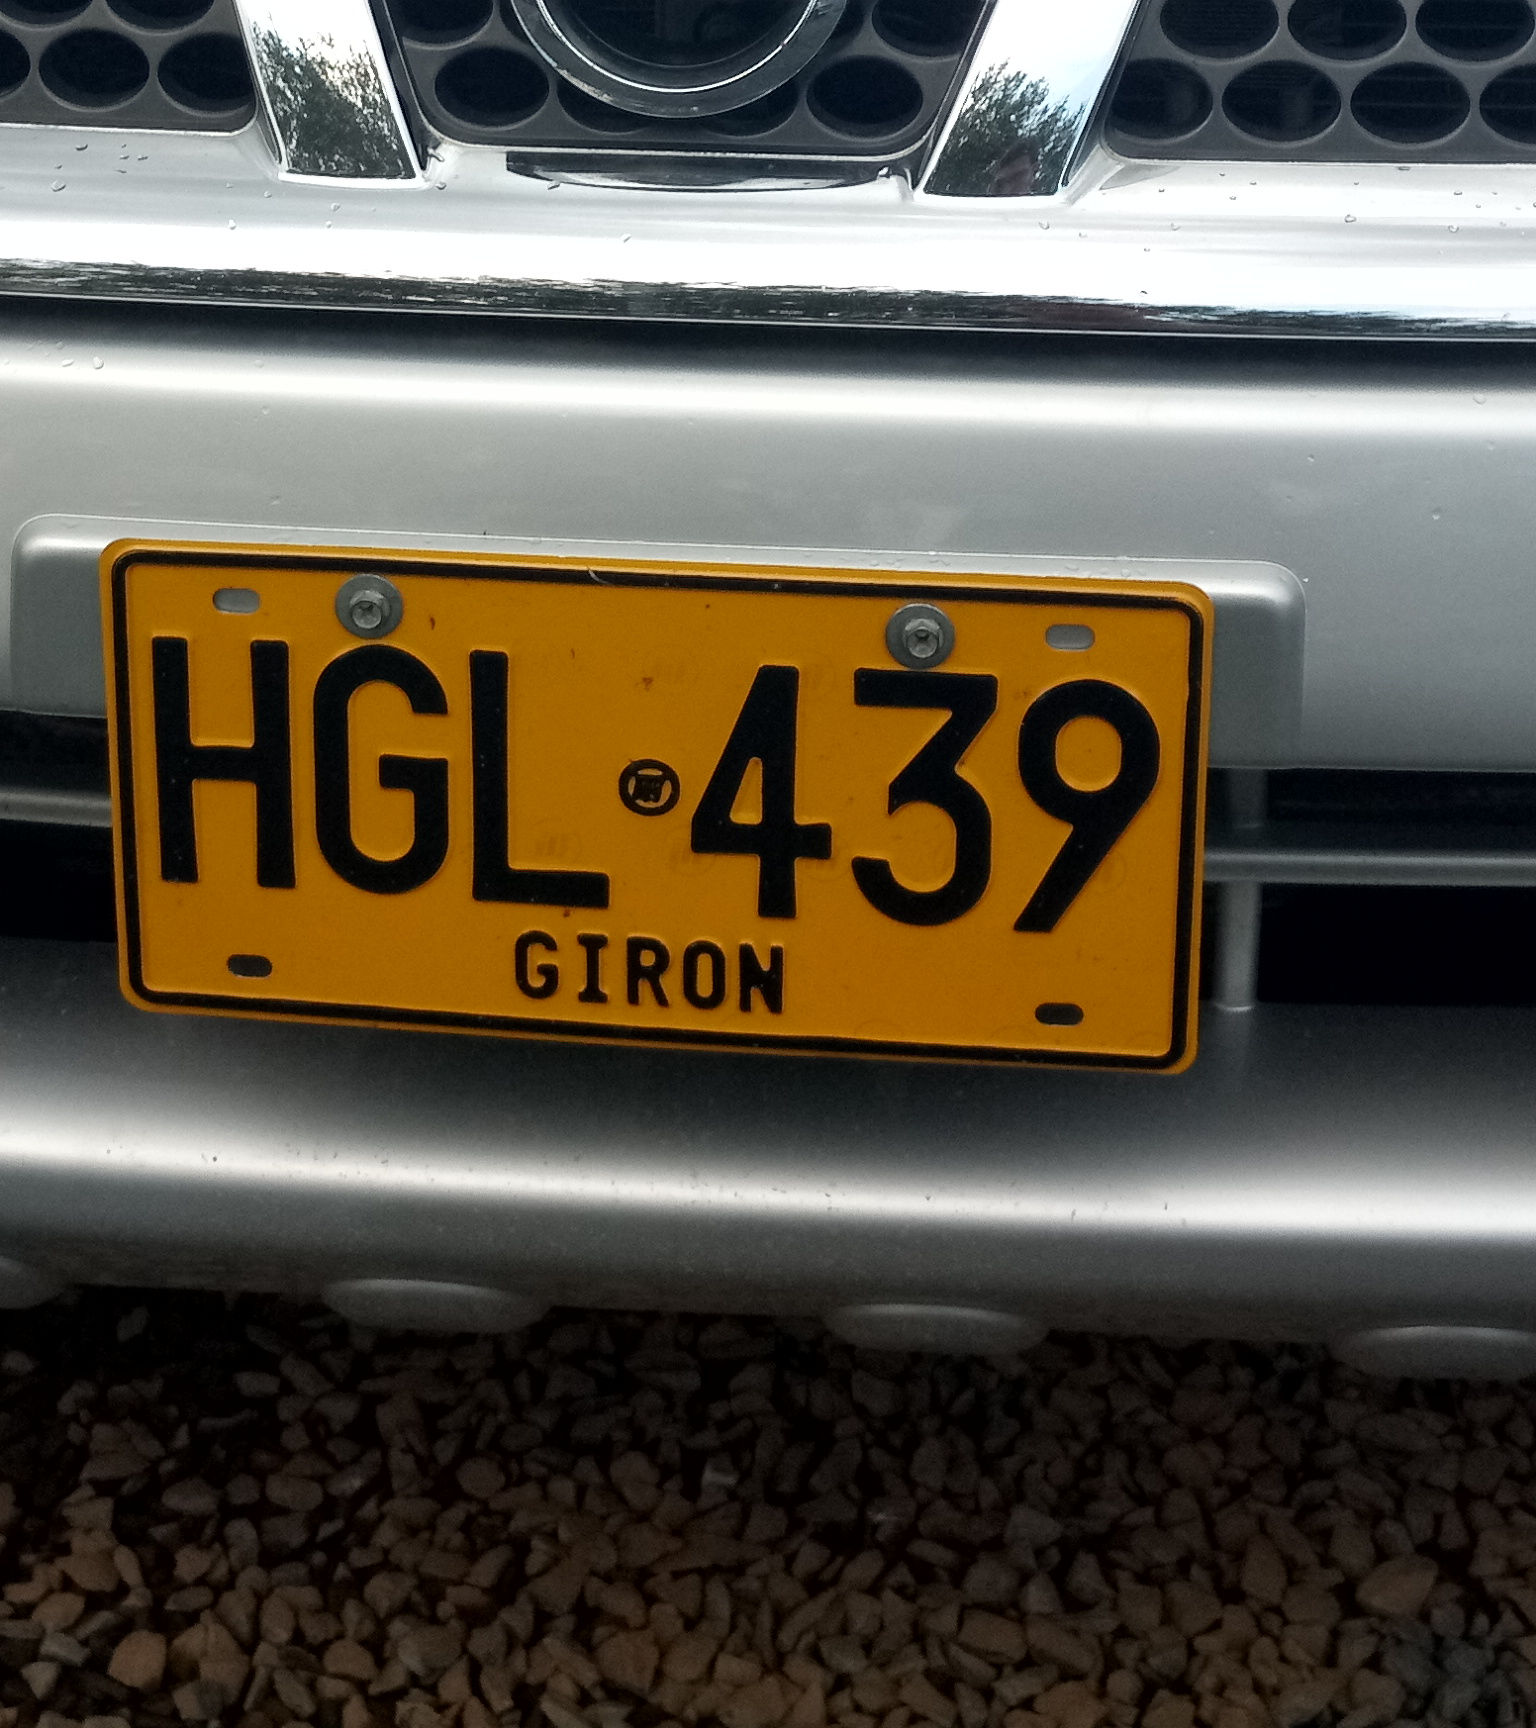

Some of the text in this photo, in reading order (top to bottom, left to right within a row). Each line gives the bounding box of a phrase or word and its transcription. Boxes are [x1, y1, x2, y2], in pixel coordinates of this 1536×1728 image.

[149, 634, 1162, 934] HGL 439
[513, 929, 786, 1015] GIRON
